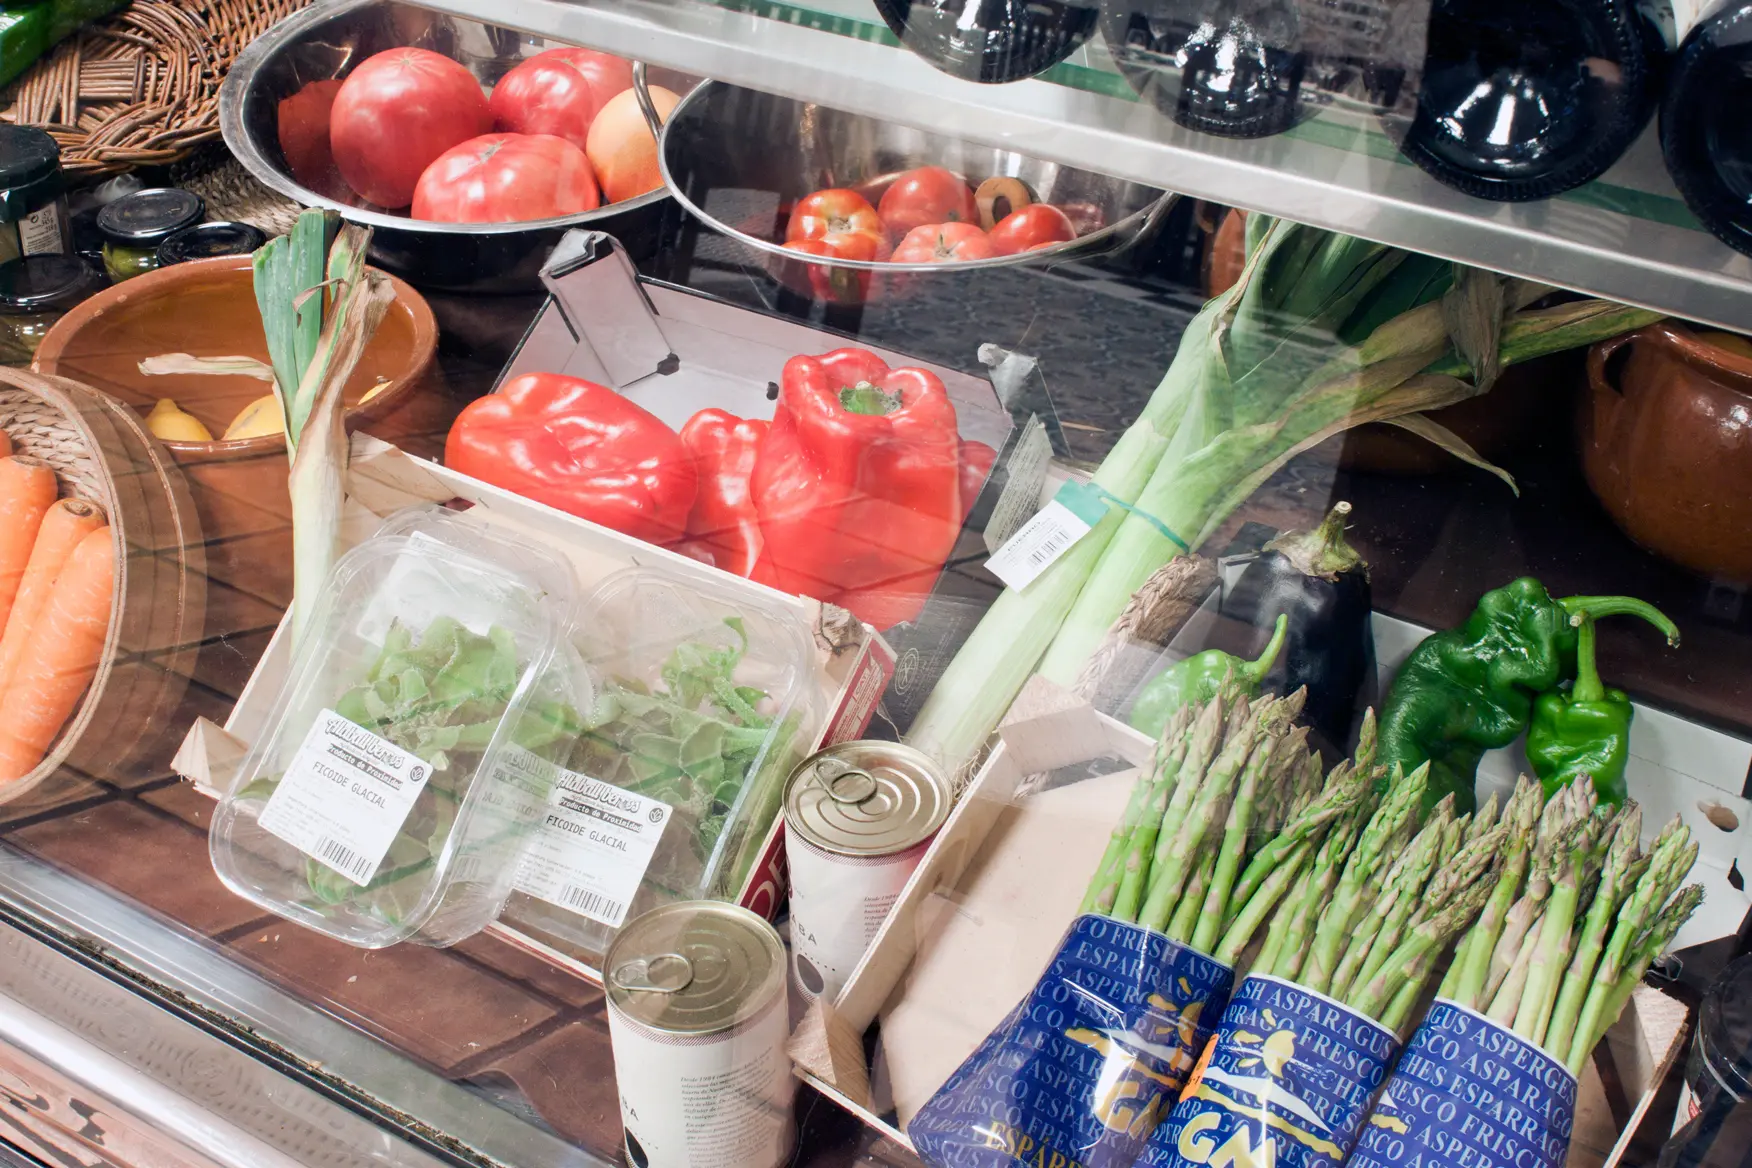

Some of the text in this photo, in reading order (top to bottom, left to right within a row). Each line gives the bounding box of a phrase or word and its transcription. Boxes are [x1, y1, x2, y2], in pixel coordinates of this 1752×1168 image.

[312, 761, 386, 810] FICOIDE GLACIAL
[546, 814, 586, 837] FICOIDE
[589, 829, 627, 852] GLACIAL
[1266, 984, 1394, 1061] ASPARAGUS
[1298, 1025, 1385, 1086] FRESCO
[1469, 1025, 1578, 1107] ASPERGES
